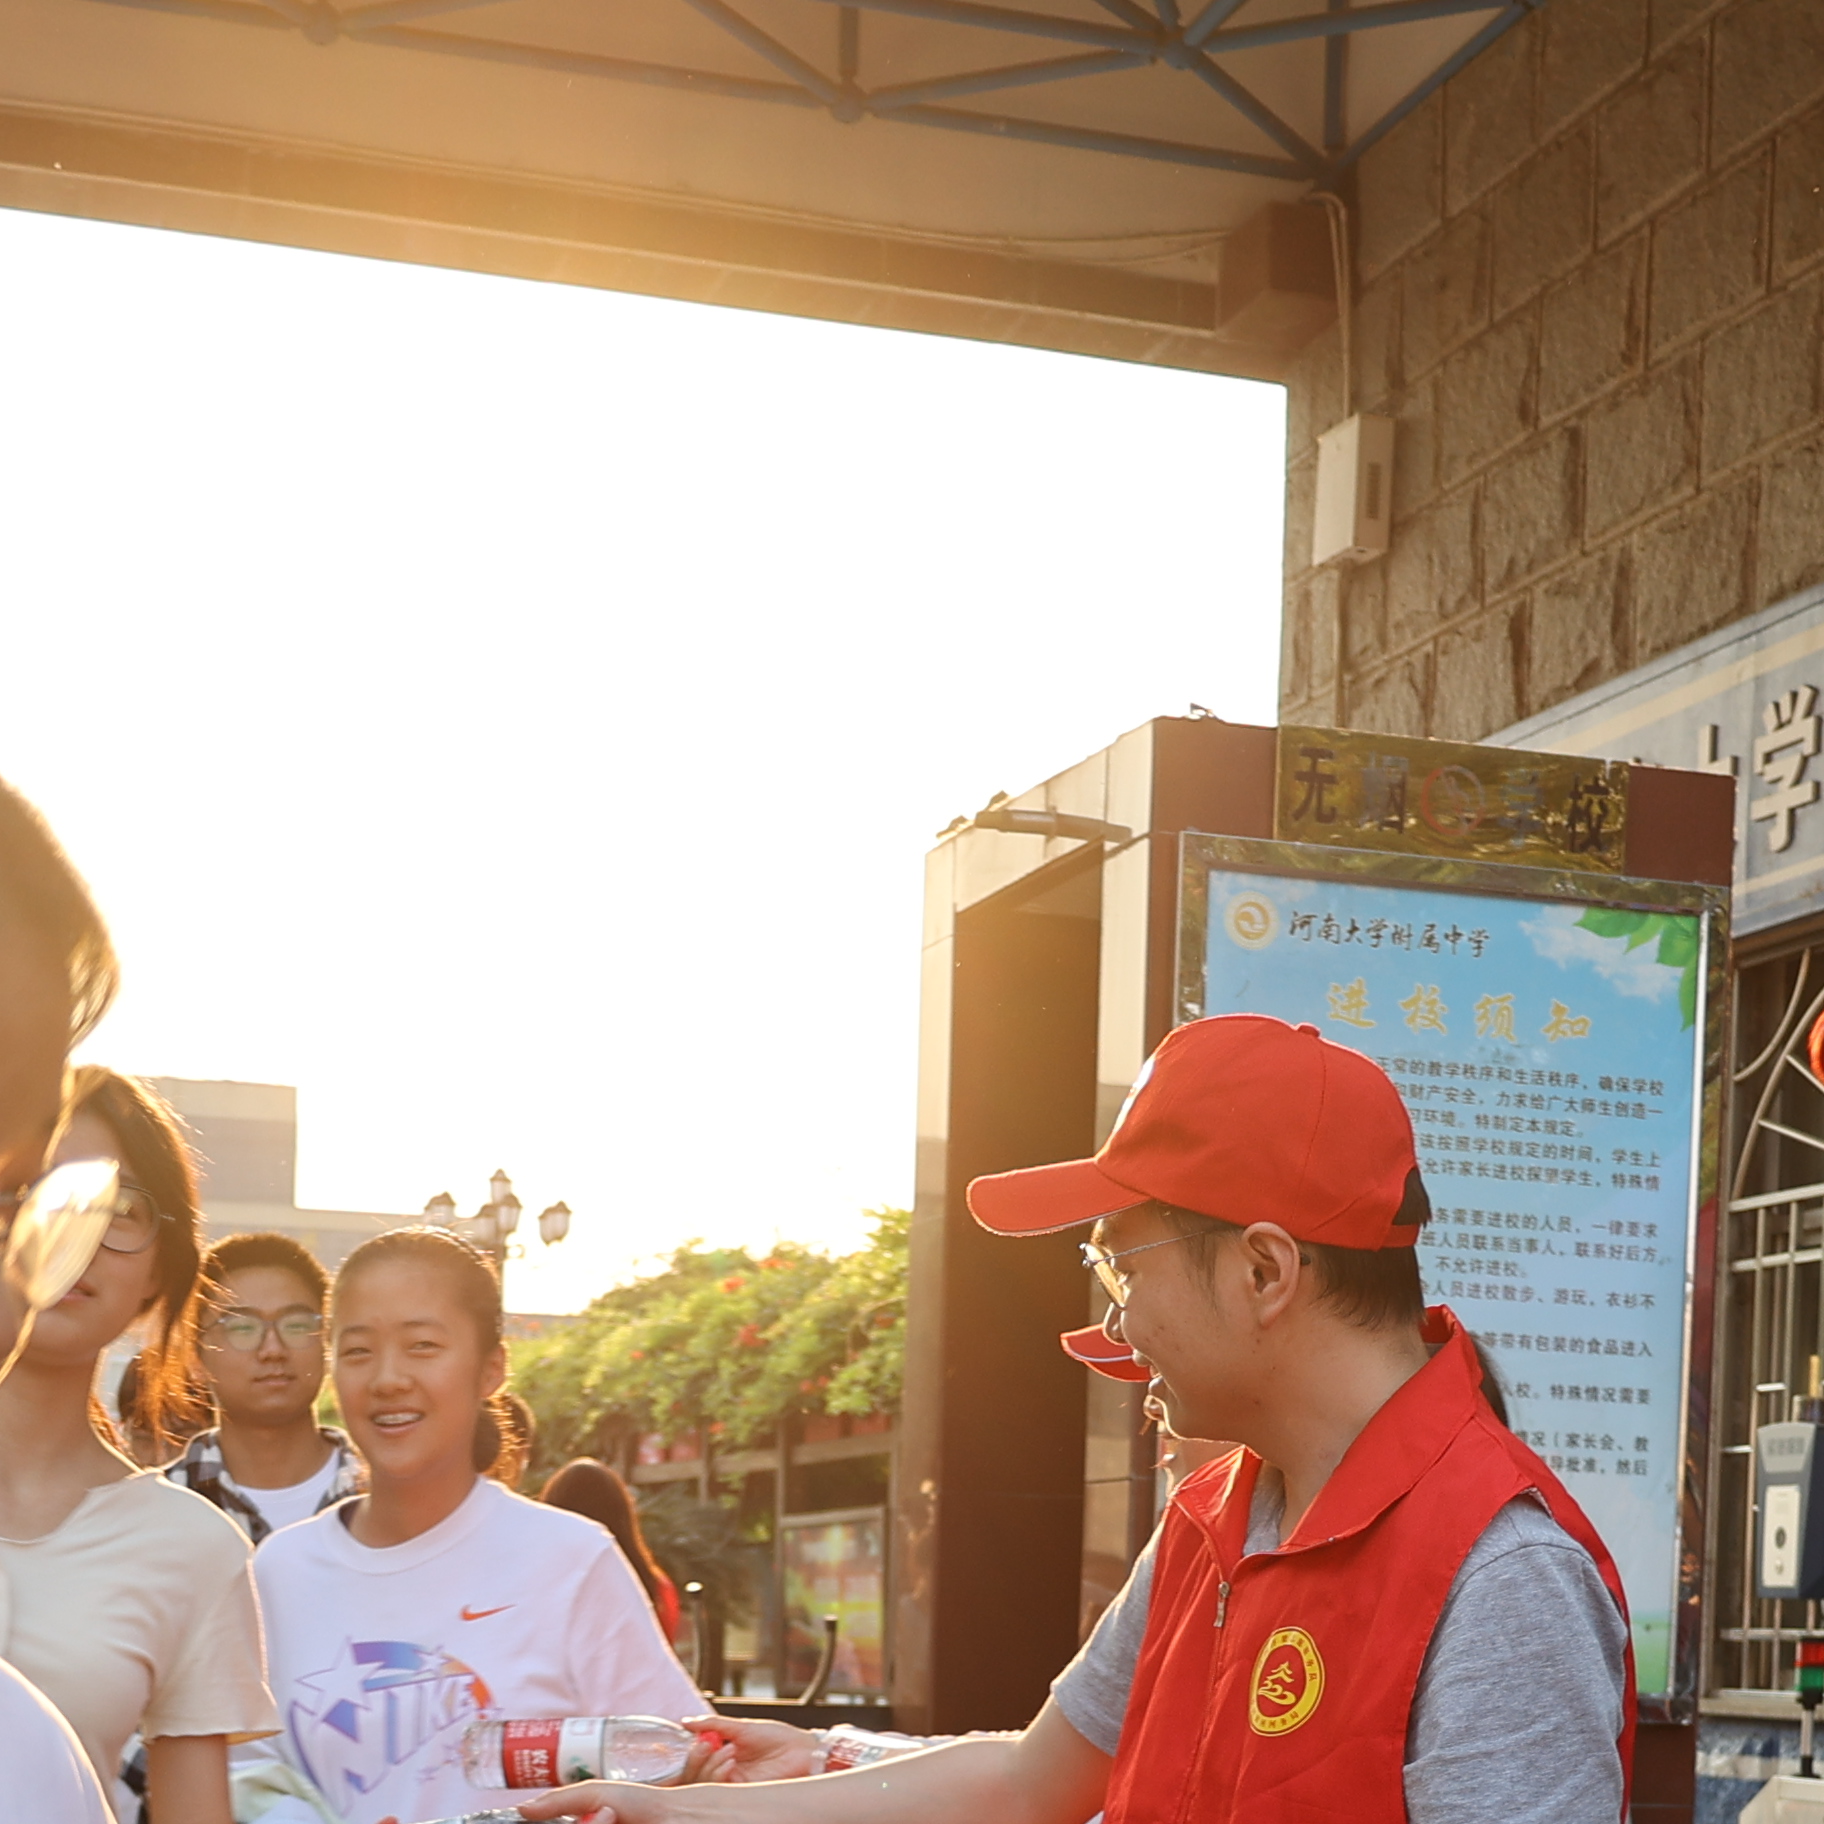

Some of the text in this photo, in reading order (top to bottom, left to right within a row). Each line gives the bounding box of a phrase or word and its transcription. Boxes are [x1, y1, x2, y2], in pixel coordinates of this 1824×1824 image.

[1288, 911, 1491, 959] 河南大学附属中学
[1328, 976, 1592, 1043] 进校须知
